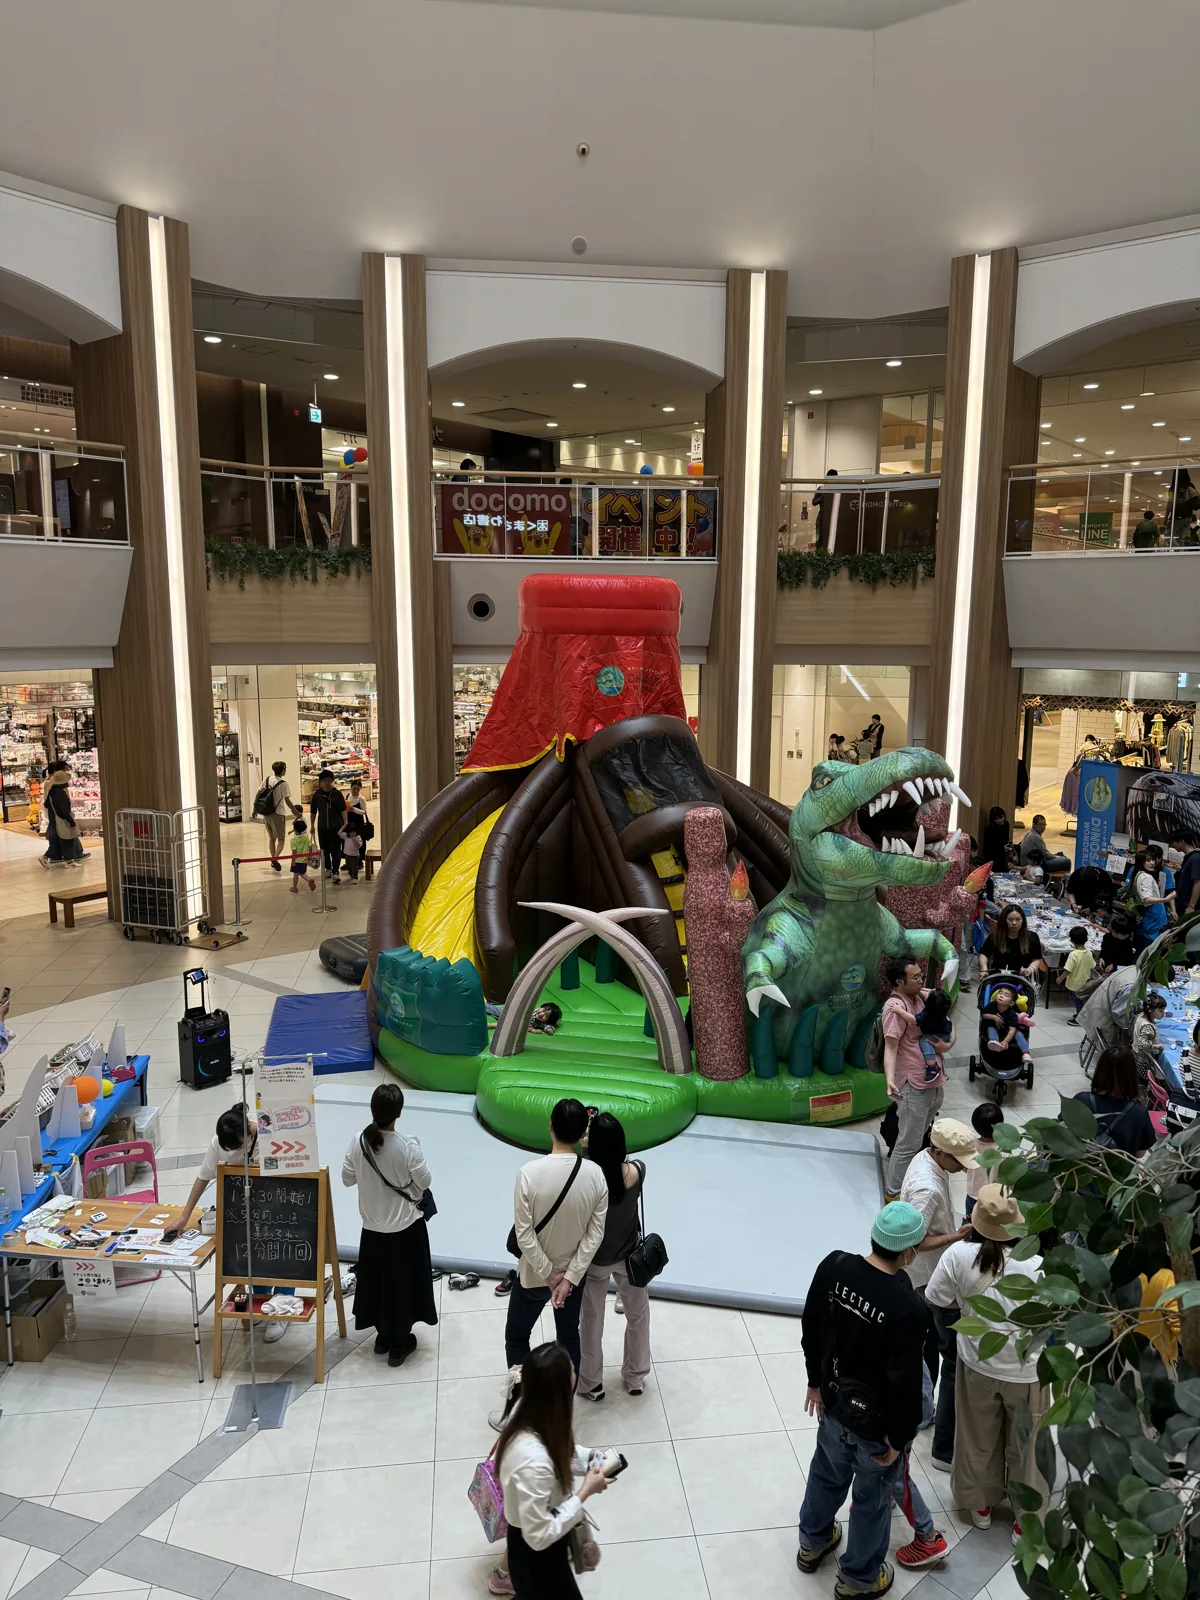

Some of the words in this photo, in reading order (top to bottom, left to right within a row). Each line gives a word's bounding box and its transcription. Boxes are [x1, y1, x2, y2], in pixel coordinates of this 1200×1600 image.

[693, 444, 701, 452] 1F
[452, 487, 567, 512] docomo
[584, 491, 709, 525] イベント
[1080, 529, 1109, 539] LINE
[1090, 816, 1101, 867] DINOSA
[834, 1281, 885, 1323] LECTRIC
